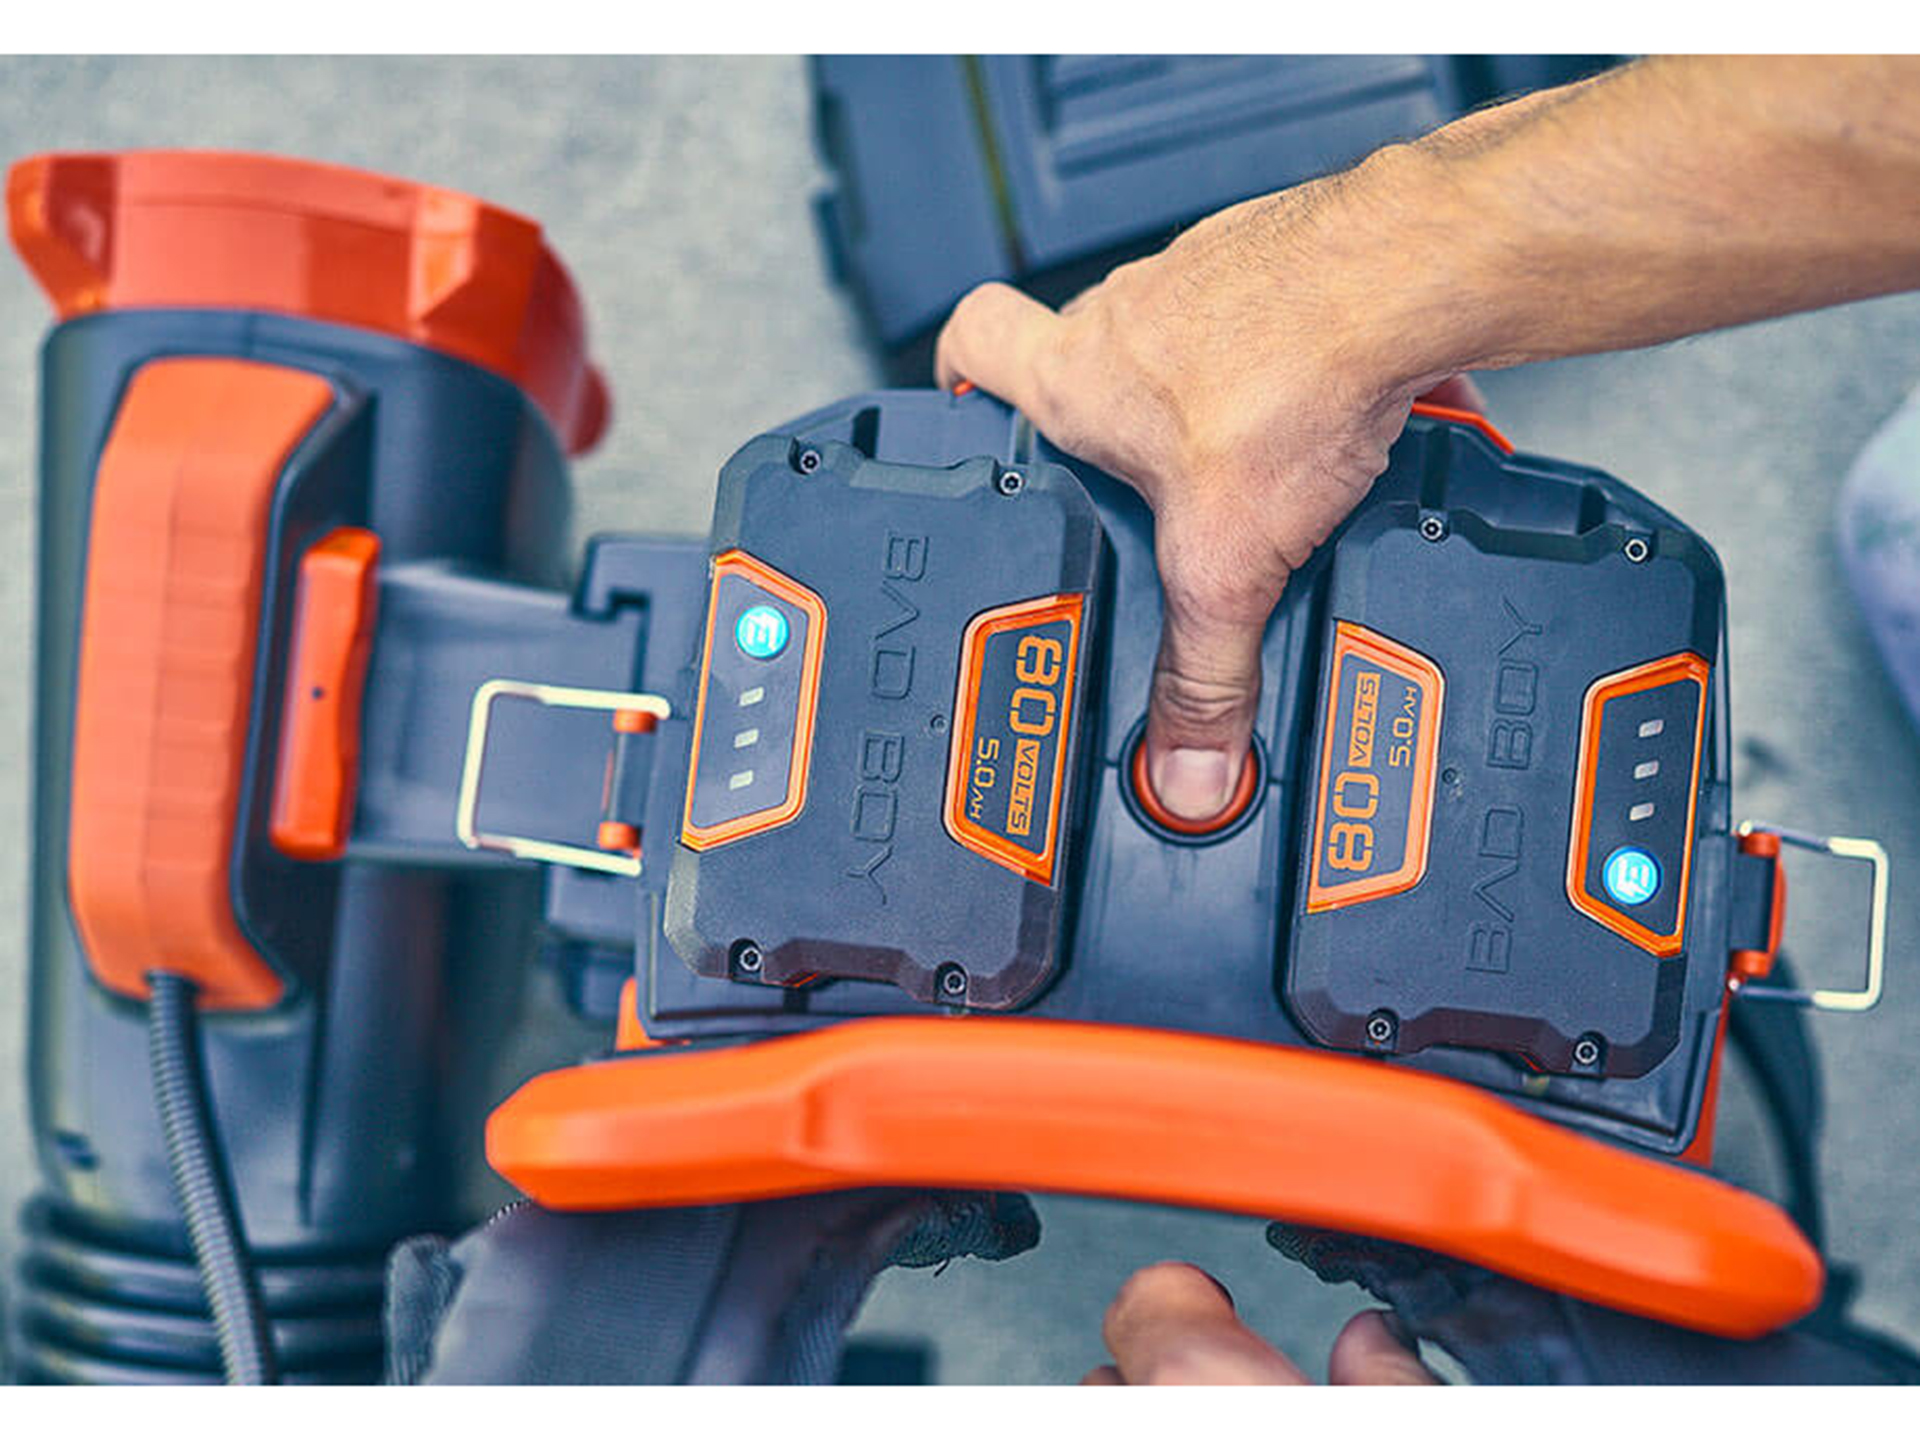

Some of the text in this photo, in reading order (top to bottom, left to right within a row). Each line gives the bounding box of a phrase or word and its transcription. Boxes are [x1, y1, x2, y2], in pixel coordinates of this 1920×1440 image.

[847, 530, 929, 905] BAD BOY
[1009, 636, 1062, 832] 80 VOLTS
[1329, 676, 1379, 872] 80 VOLTS
[1465, 597, 1542, 974] BAD BOY
